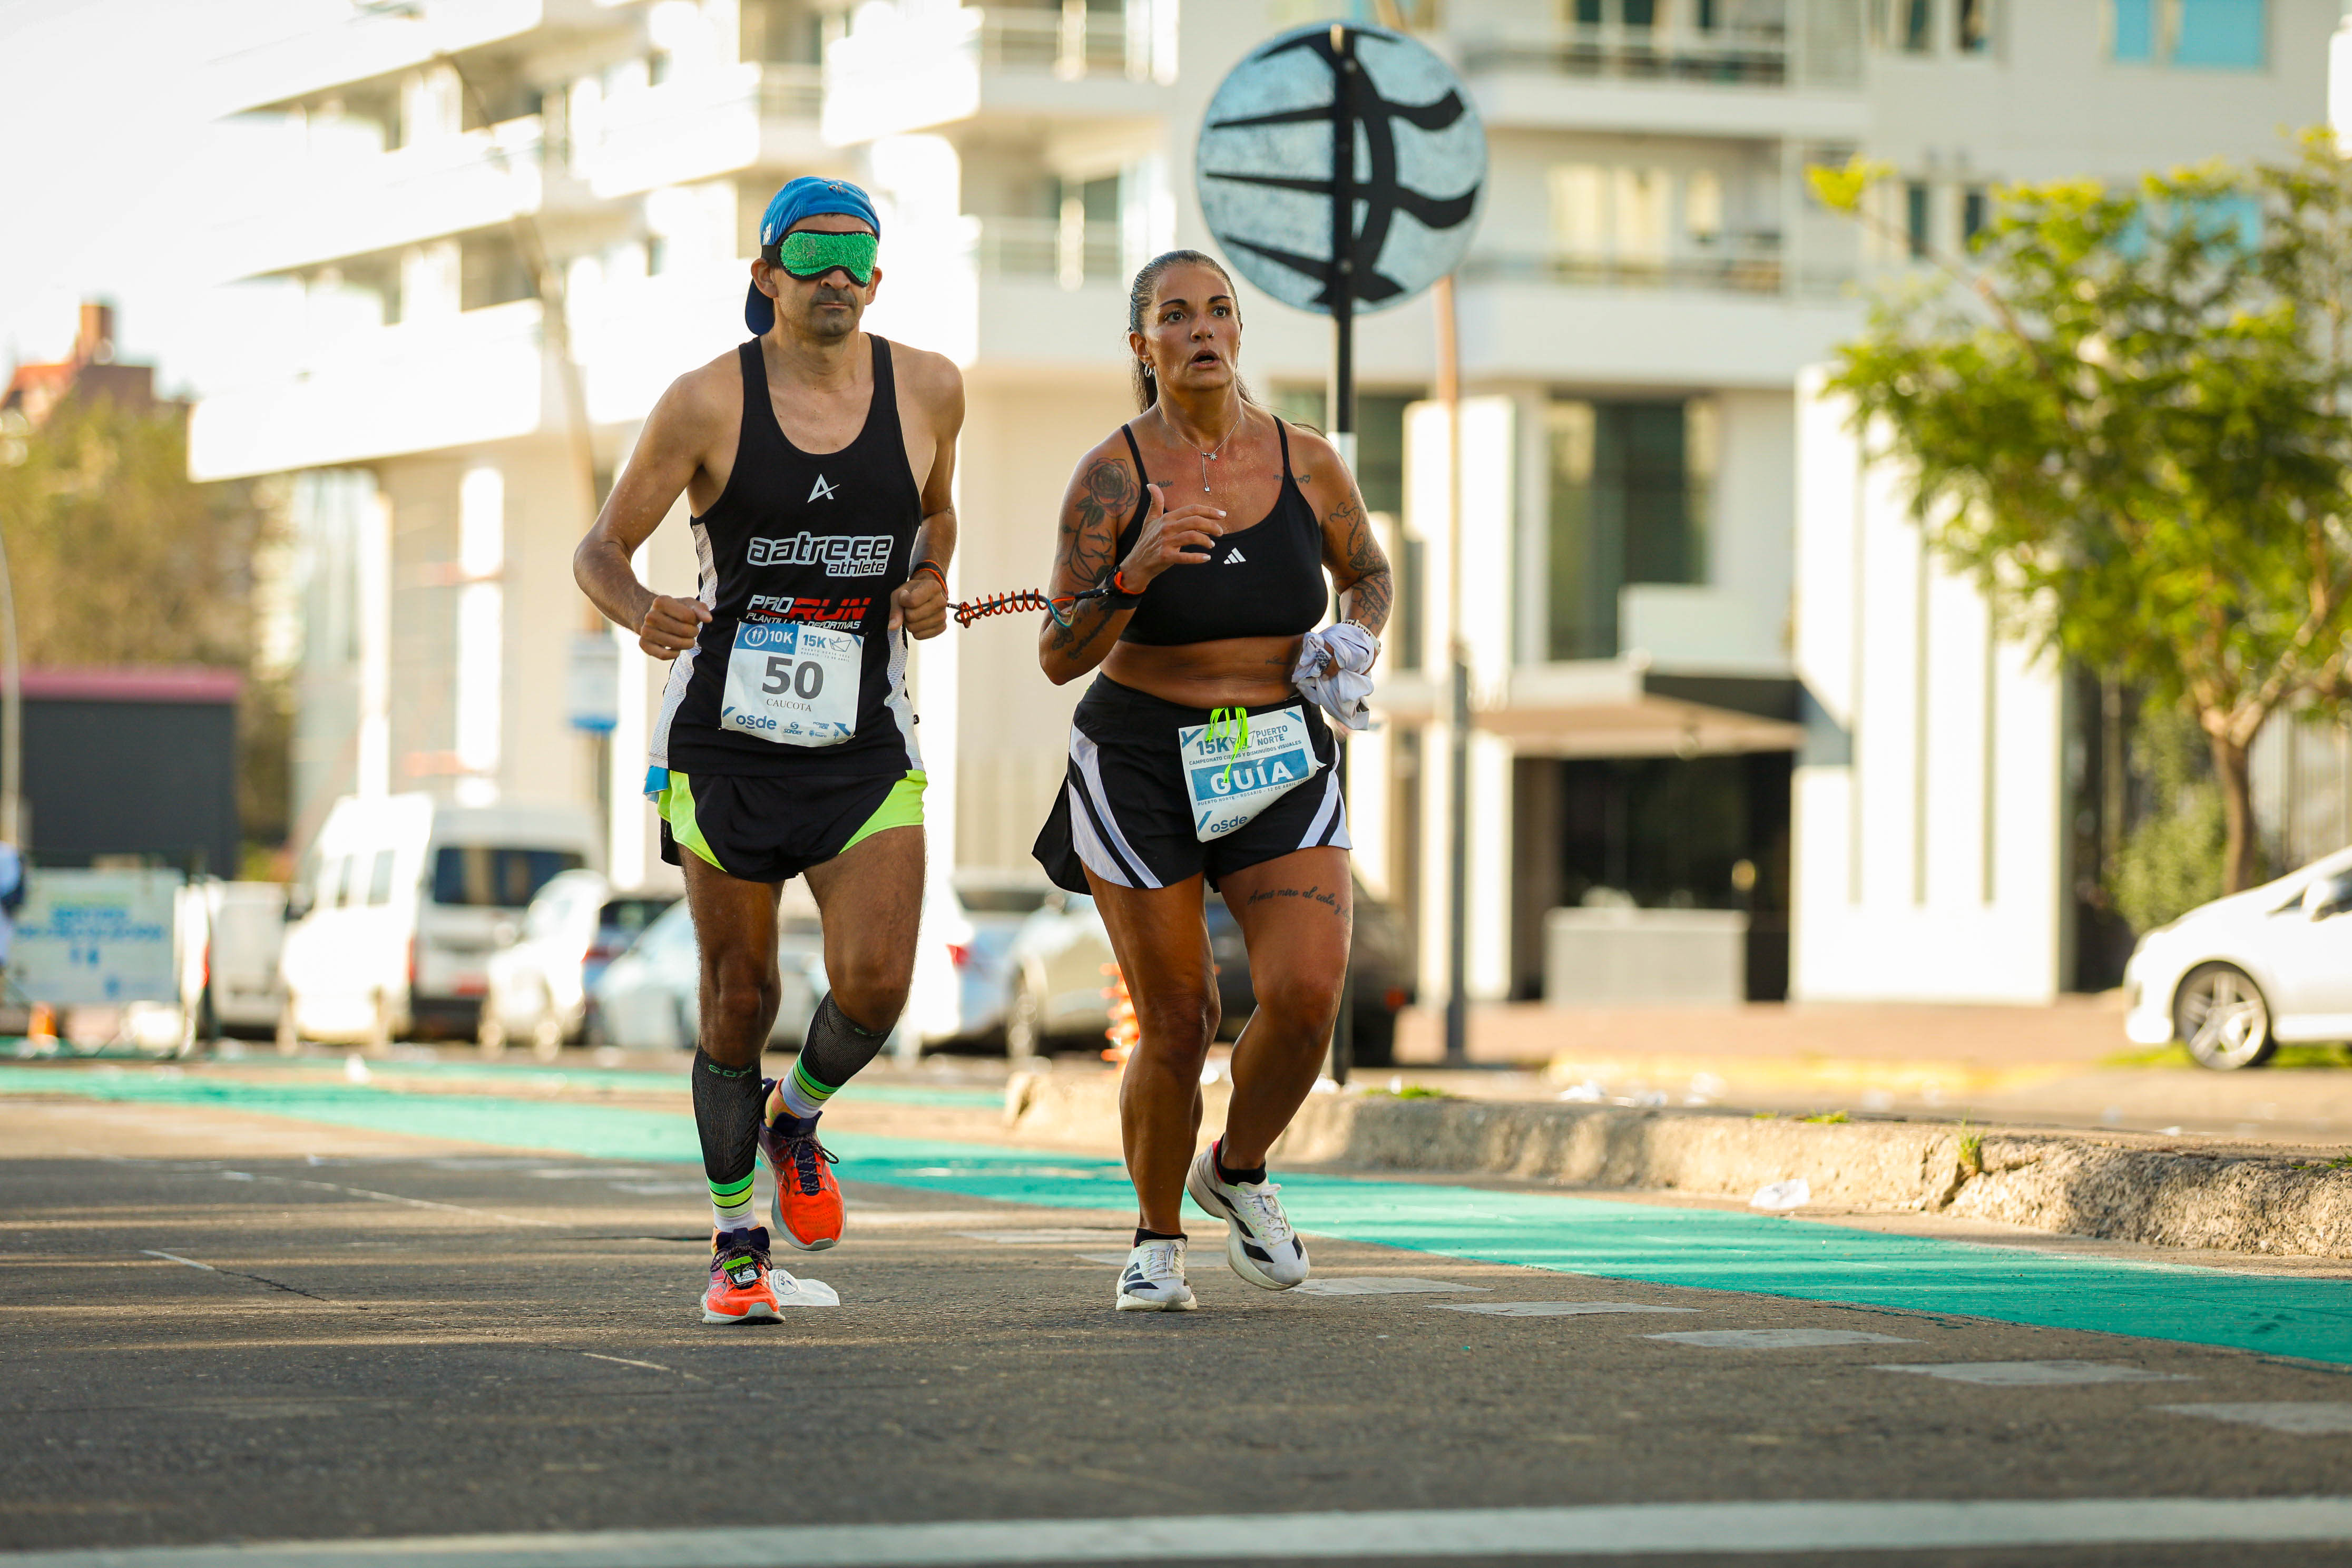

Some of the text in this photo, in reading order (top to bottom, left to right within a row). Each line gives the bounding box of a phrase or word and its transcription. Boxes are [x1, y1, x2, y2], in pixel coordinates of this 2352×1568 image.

[747, 531, 894, 566] aatrece
[826, 558, 888, 577] athlete
[807, 621, 861, 630] DEPORTIVAS
[769, 630, 827, 649] 10K 15K
[762, 656, 824, 699] 50
[766, 698, 812, 712] CAUCOTA
[736, 714, 777, 730] osde
[1197, 724, 1288, 756] 15K PUERTO
[1257, 733, 1285, 746] NORTE
[1189, 757, 1222, 766] CAMPEONATO
[1247, 746, 1277, 757] DISMINUÍDOS
[1277, 739, 1302, 749] VISUALES
[1210, 758, 1294, 795] GUÍA
[1211, 815, 1248, 832] osde
[1302, 886, 1318, 898] al
